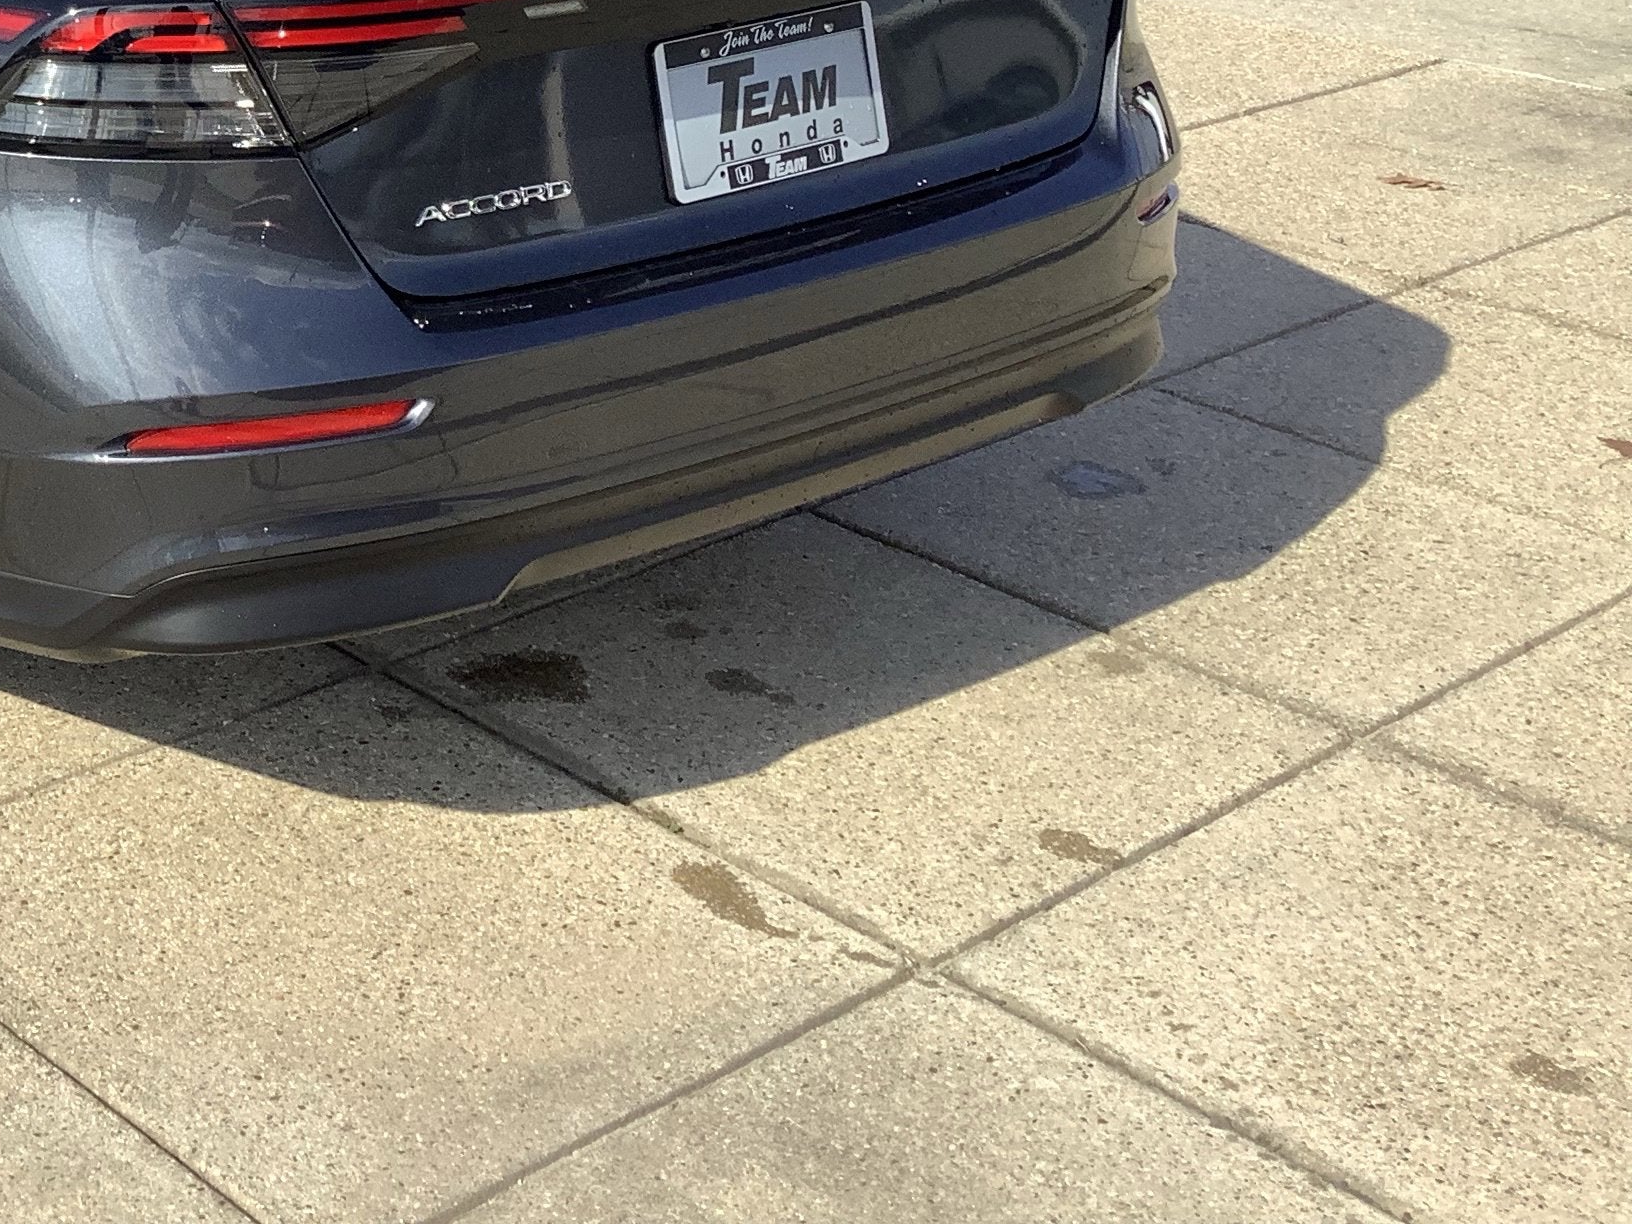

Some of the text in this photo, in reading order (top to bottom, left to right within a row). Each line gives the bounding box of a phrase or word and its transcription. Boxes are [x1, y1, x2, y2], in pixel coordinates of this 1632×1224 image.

[718, 17, 814, 56] Join The Team!
[707, 56, 837, 135] TEAM
[719, 117, 844, 162] Honda
[765, 154, 808, 179] TEAM
[415, 179, 572, 227] ACCORD
